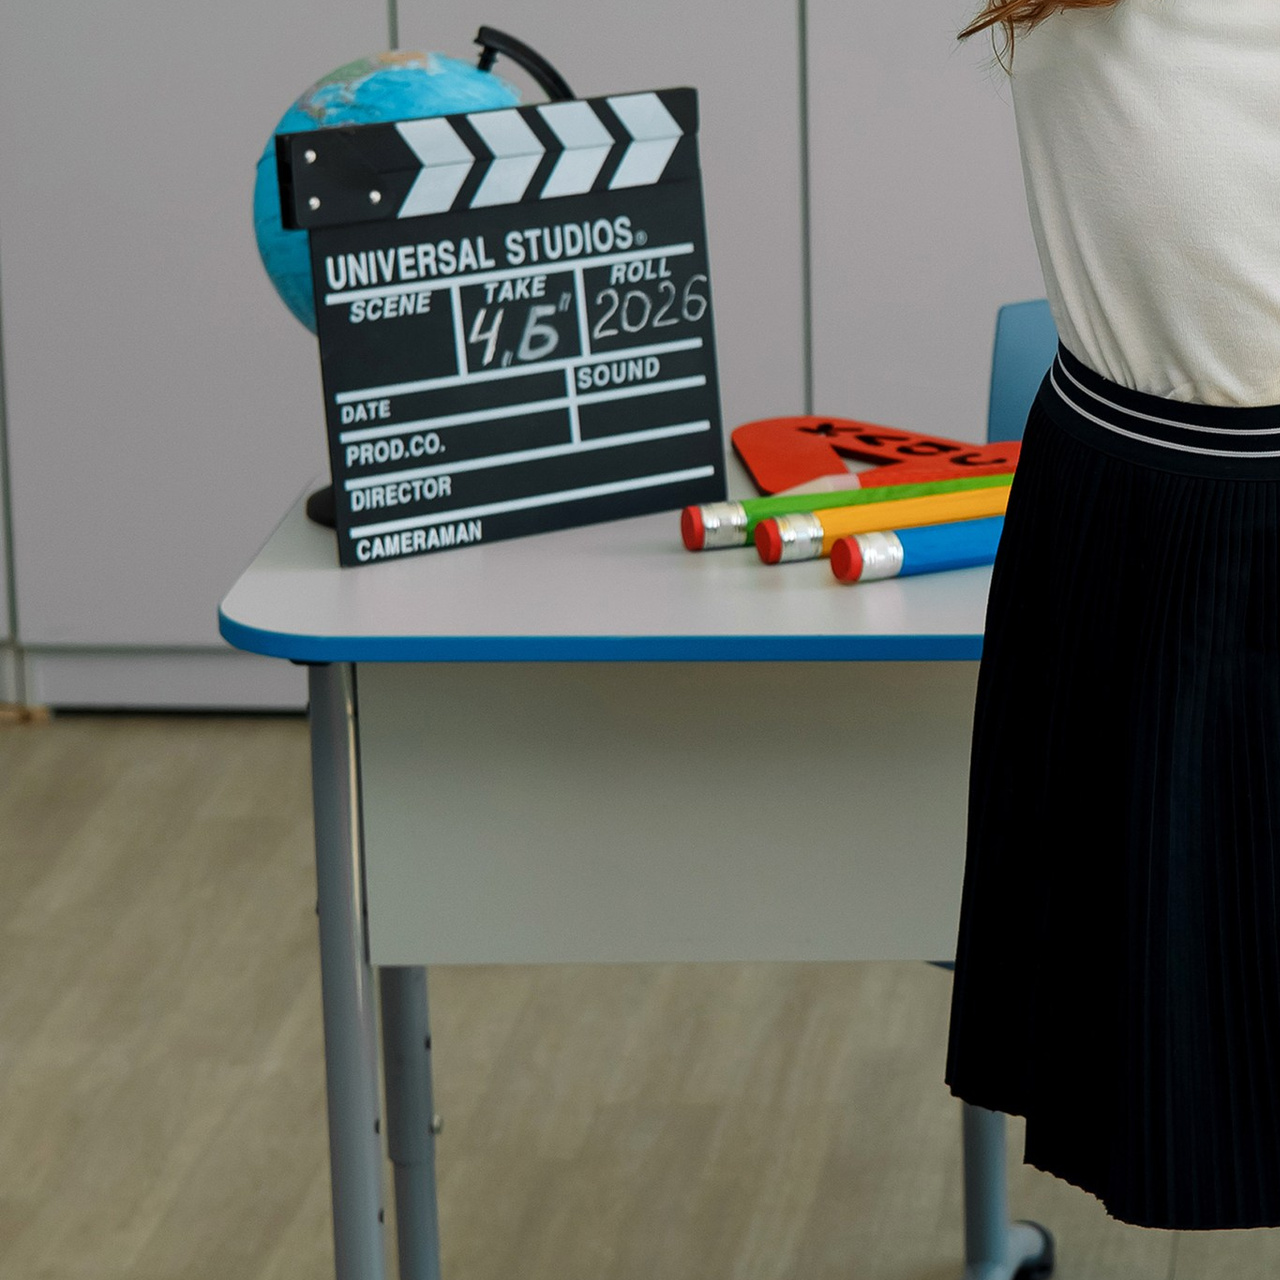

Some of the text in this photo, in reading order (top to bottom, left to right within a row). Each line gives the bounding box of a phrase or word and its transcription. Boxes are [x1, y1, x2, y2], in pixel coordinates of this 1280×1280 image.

[325, 235, 496, 291] UNIVERSAL
[610, 257, 672, 286] ROLL
[483, 274, 547, 305] TAKE
[593, 274, 708, 340] 2026
[349, 291, 432, 324] SCENE
[576, 356, 661, 390] SOUND
[341, 399, 391, 424] DATE
[345, 432, 446, 468] PROD.CO.
[351, 475, 452, 512] DIRECTOR
[356, 520, 482, 562] CAMERAMAN
